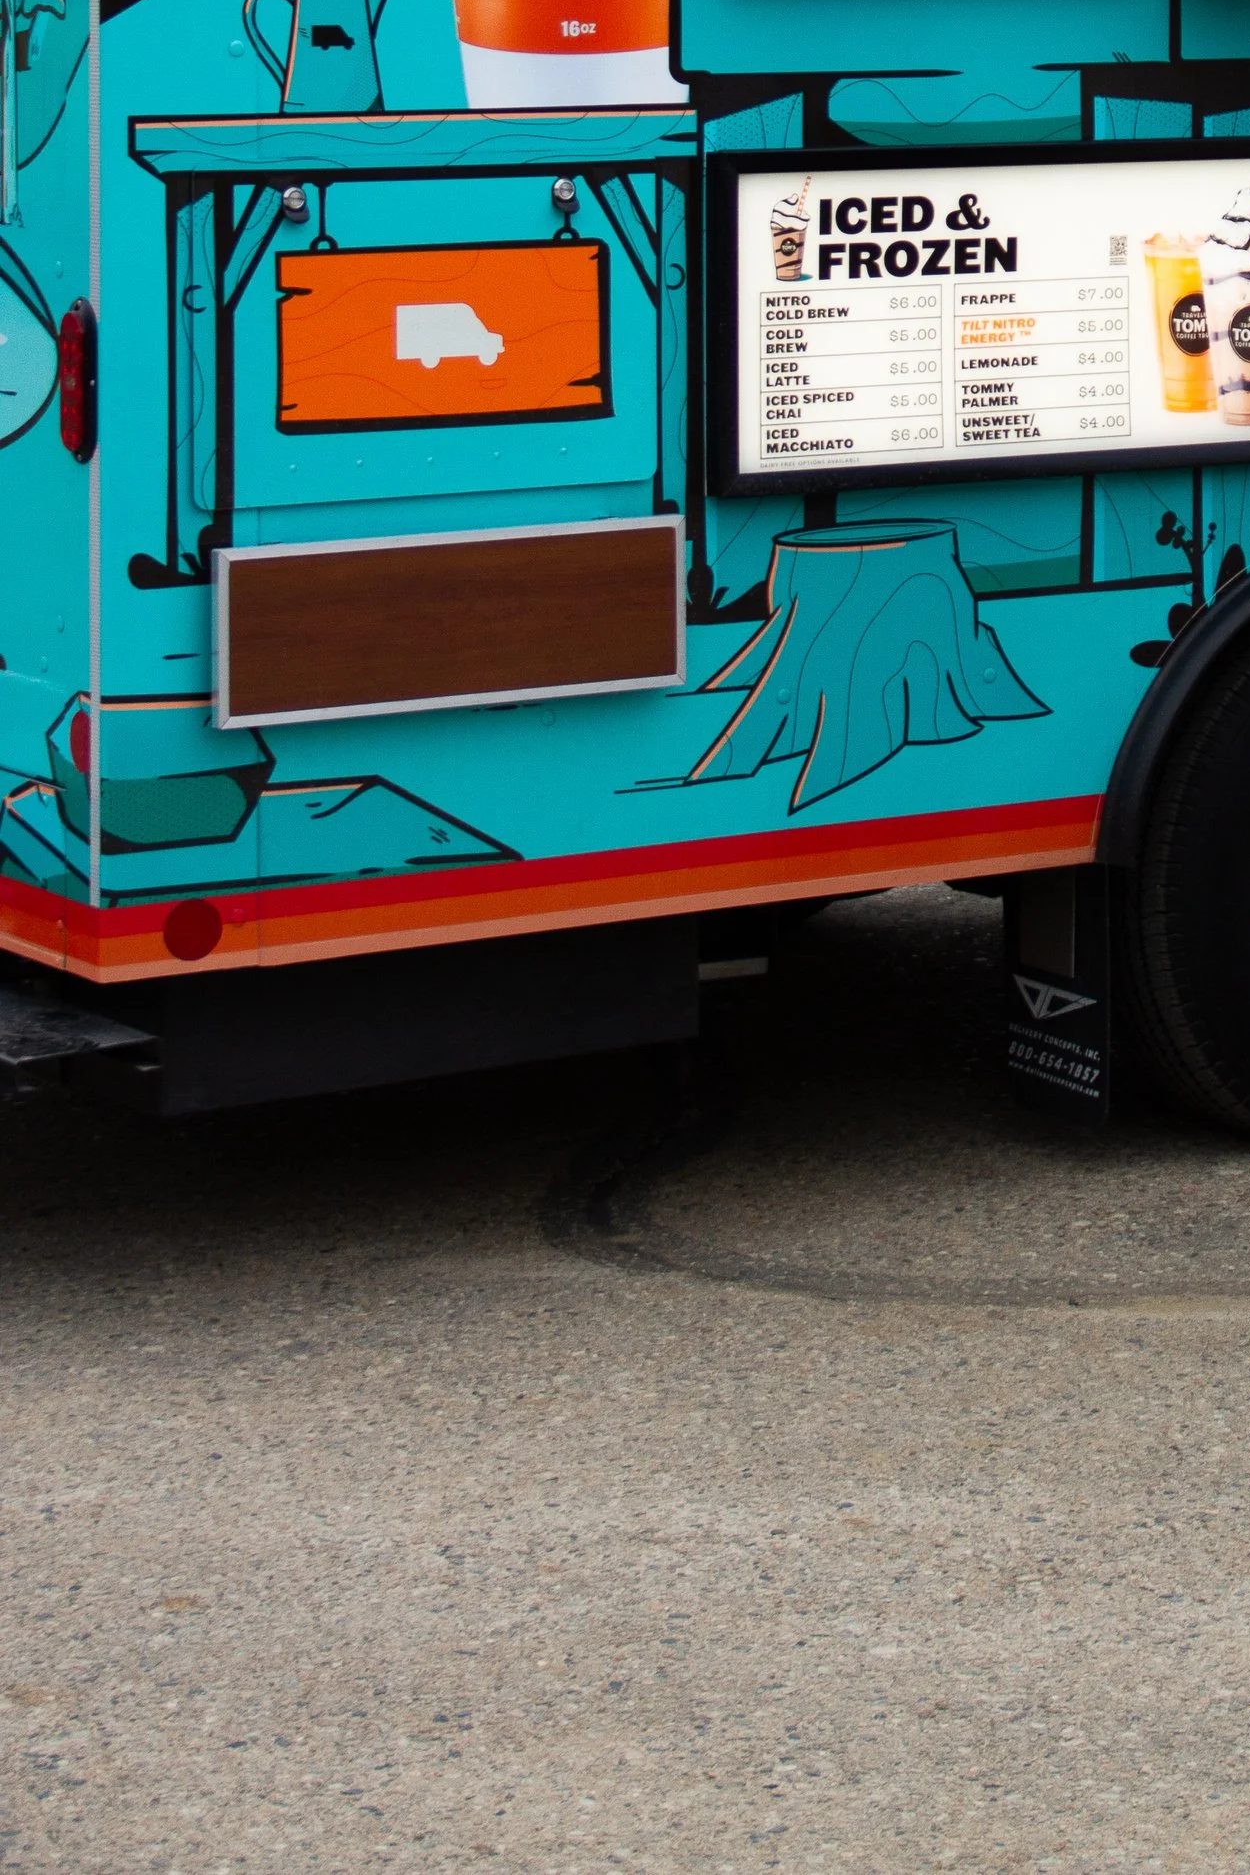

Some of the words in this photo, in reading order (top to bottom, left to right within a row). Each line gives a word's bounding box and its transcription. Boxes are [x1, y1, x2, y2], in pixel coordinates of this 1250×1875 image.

[561, 20, 597, 37] 16oz
[819, 196, 934, 235] ICED
[945, 193, 991, 230] &
[818, 236, 1018, 281] FROZEN
[766, 296, 811, 307] NITRO
[889, 295, 937, 309] $6.00
[961, 293, 1016, 305] FRAPPE
[1078, 287, 1124, 301] $7.00
[766, 309, 804, 321] COLD
[807, 307, 850, 319] BREW
[962, 320, 990, 331] TILT
[993, 318, 1036, 330] NITRO
[1078, 319, 1124, 333] $5.00
[766, 329, 804, 340] COLD
[889, 328, 937, 342] $5.00
[961, 331, 1016, 345] ENERGY
[1176, 332, 1197, 340] COFFEE
[766, 342, 808, 354] BREW
[766, 362, 798, 374] ICED
[890, 360, 937, 375] $5.00
[961, 356, 1039, 370] LEMONADE
[1078, 351, 1124, 365] $4.00
[766, 375, 811, 387] LATTE
[962, 382, 1015, 395] TOMMY
[1079, 384, 1124, 398] $4.00
[766, 395, 799, 406] ICED
[803, 391, 855, 404] SPICED
[890, 393, 938, 408] $5.00
[962, 395, 1018, 408] PALMER
[766, 408, 802, 420] CHAI
[962, 413, 1036, 428] UNSWEET/
[1080, 415, 1125, 430] $4.00
[766, 428, 799, 440] ICED
[891, 427, 939, 442] $6.00
[963, 429, 1009, 442] SWEET
[1014, 427, 1041, 439] TEA
[766, 438, 854, 454] MACCHIATO
[1085, 1047, 1101, 1061] INC.
